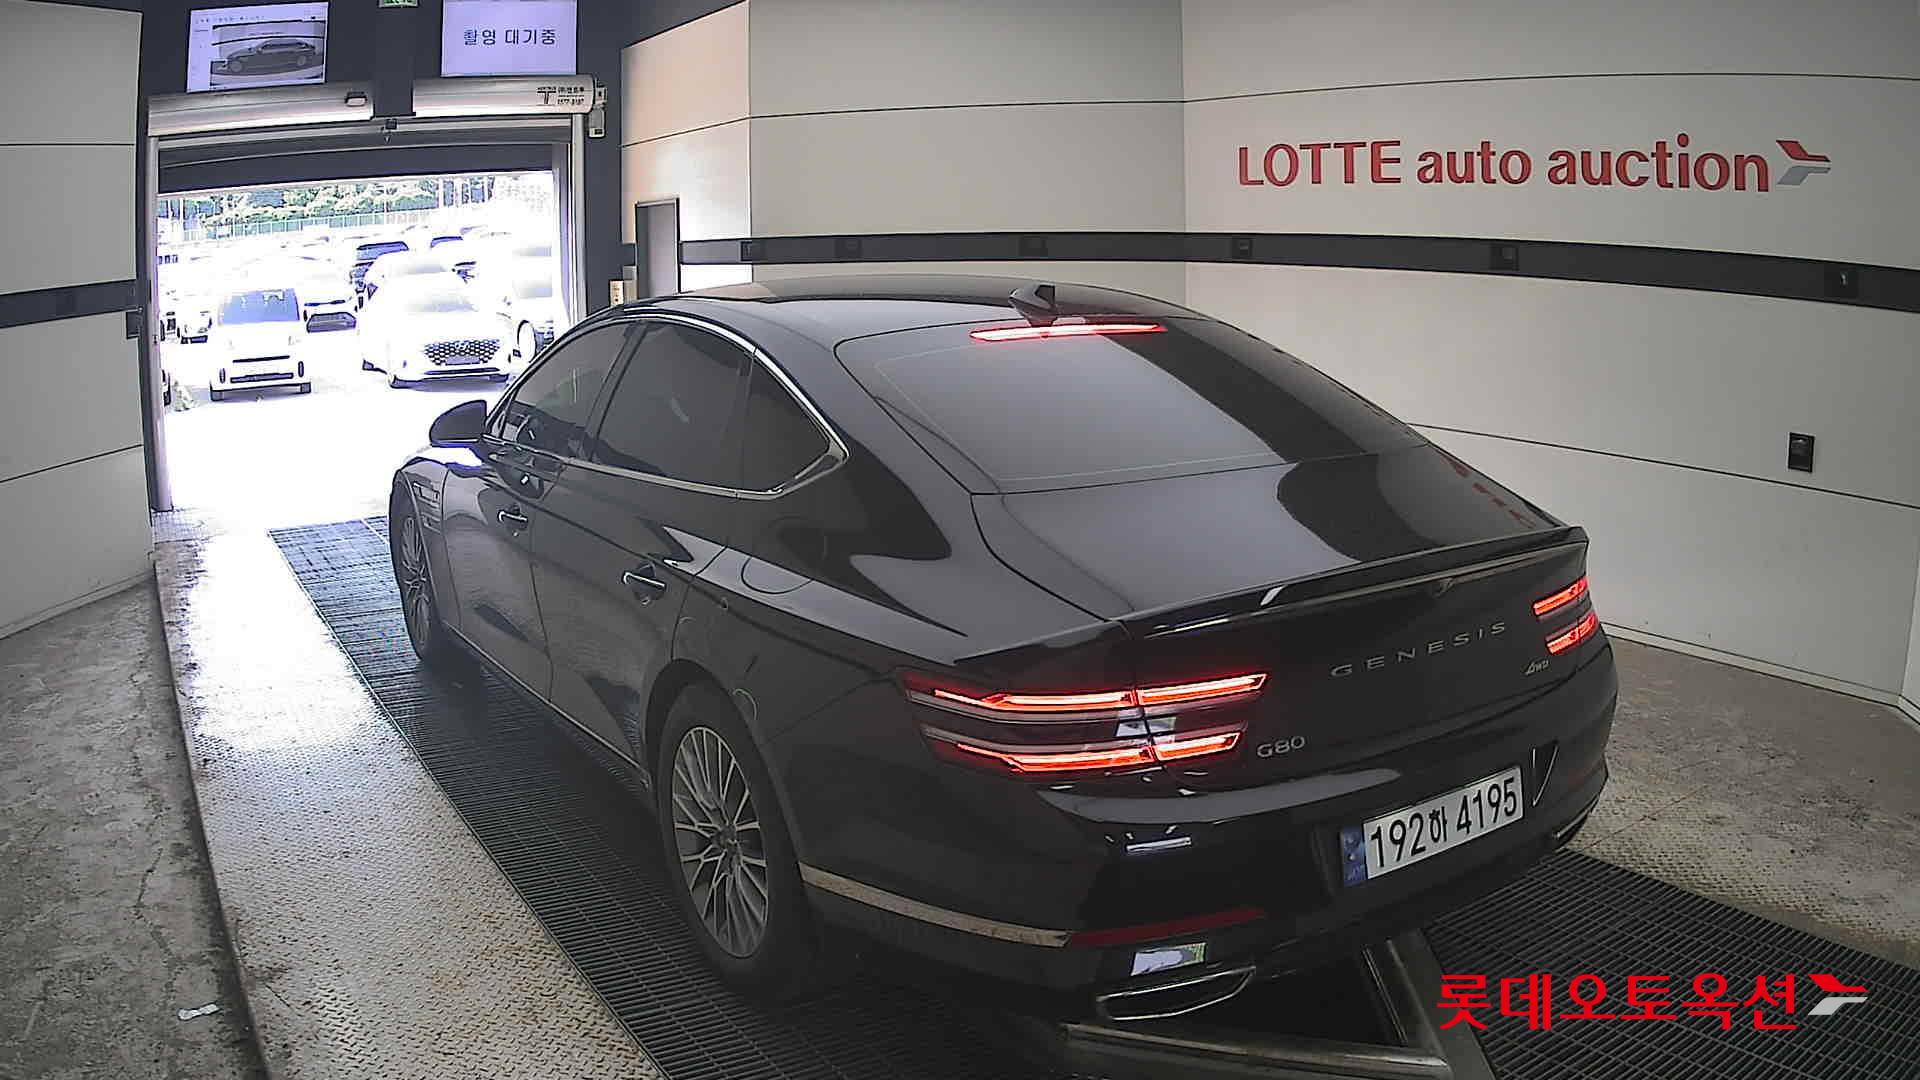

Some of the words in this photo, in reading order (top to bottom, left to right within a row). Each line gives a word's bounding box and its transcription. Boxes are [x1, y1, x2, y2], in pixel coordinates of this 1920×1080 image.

[505, 28, 556, 45] 대기중
[1239, 140, 1401, 187] LOTTE
[1416, 140, 1532, 185] auto
[1547, 132, 1769, 193] auction
[1330, 621, 1506, 678] GENESIS
[1256, 735, 1306, 758] G80
[1370, 804, 1449, 869] 192하
[1456, 776, 1518, 836] 4195
